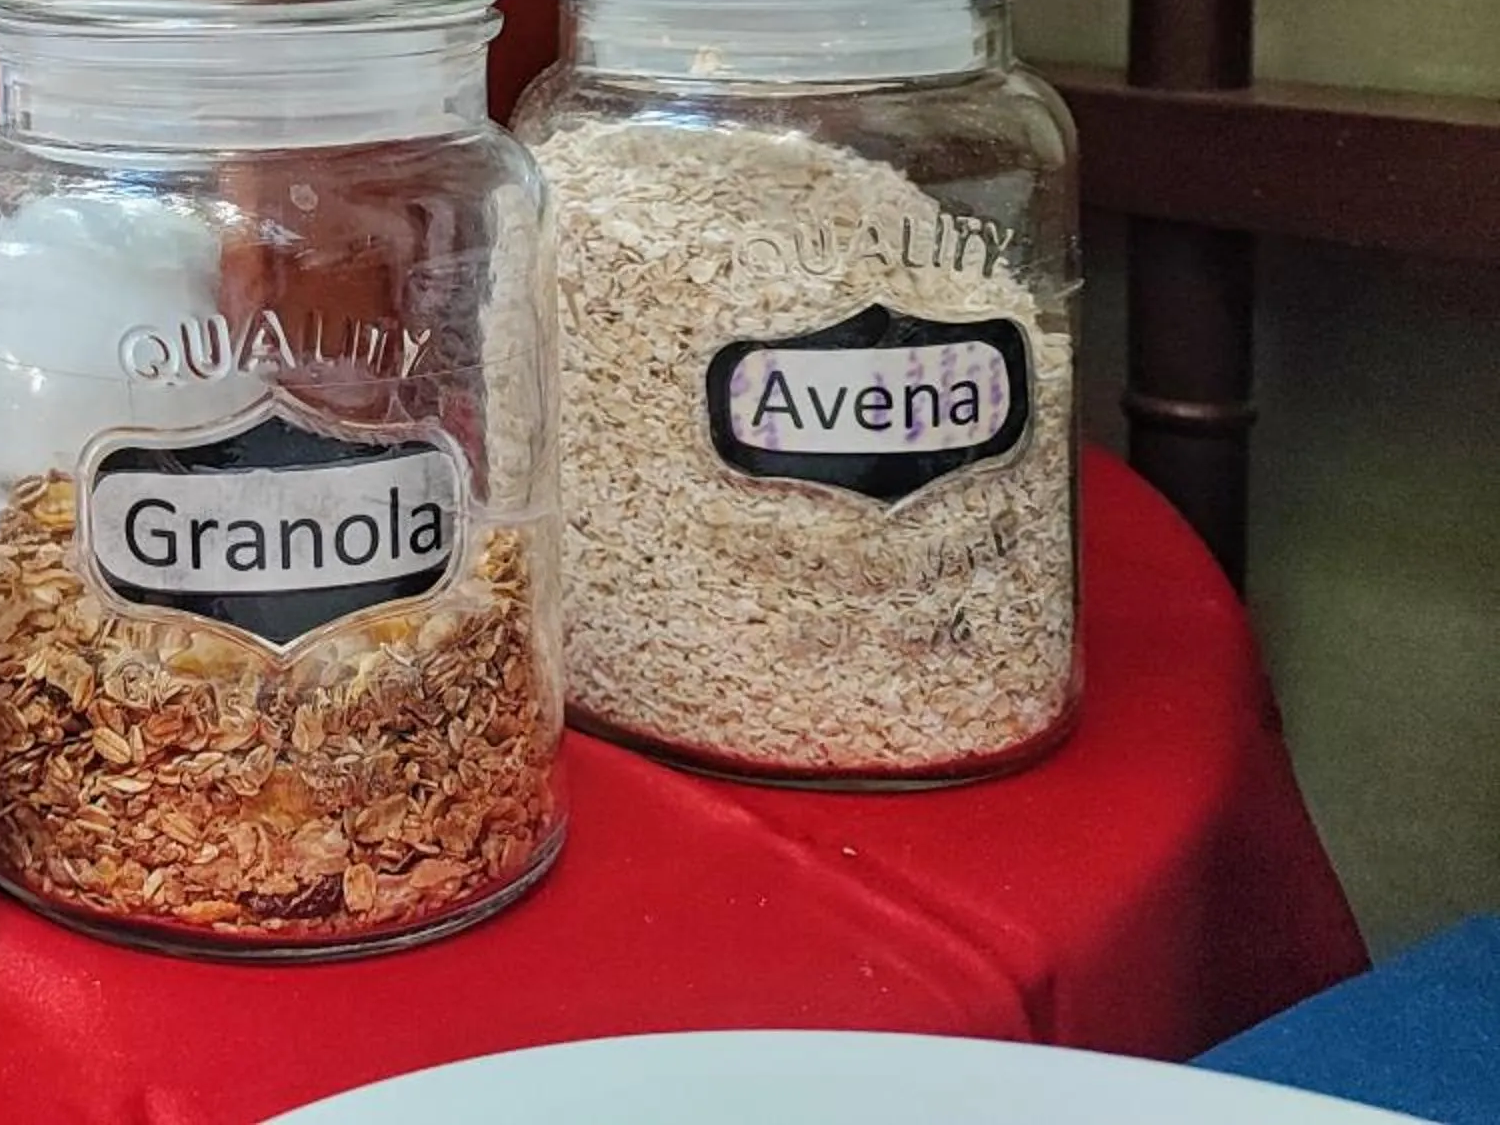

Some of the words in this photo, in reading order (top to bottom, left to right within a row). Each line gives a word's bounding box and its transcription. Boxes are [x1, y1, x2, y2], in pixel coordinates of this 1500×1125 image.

[732, 213, 1015, 279] QUALITY
[117, 309, 432, 386] QUALITY
[750, 370, 981, 431] Avena
[124, 486, 443, 572] Granola
